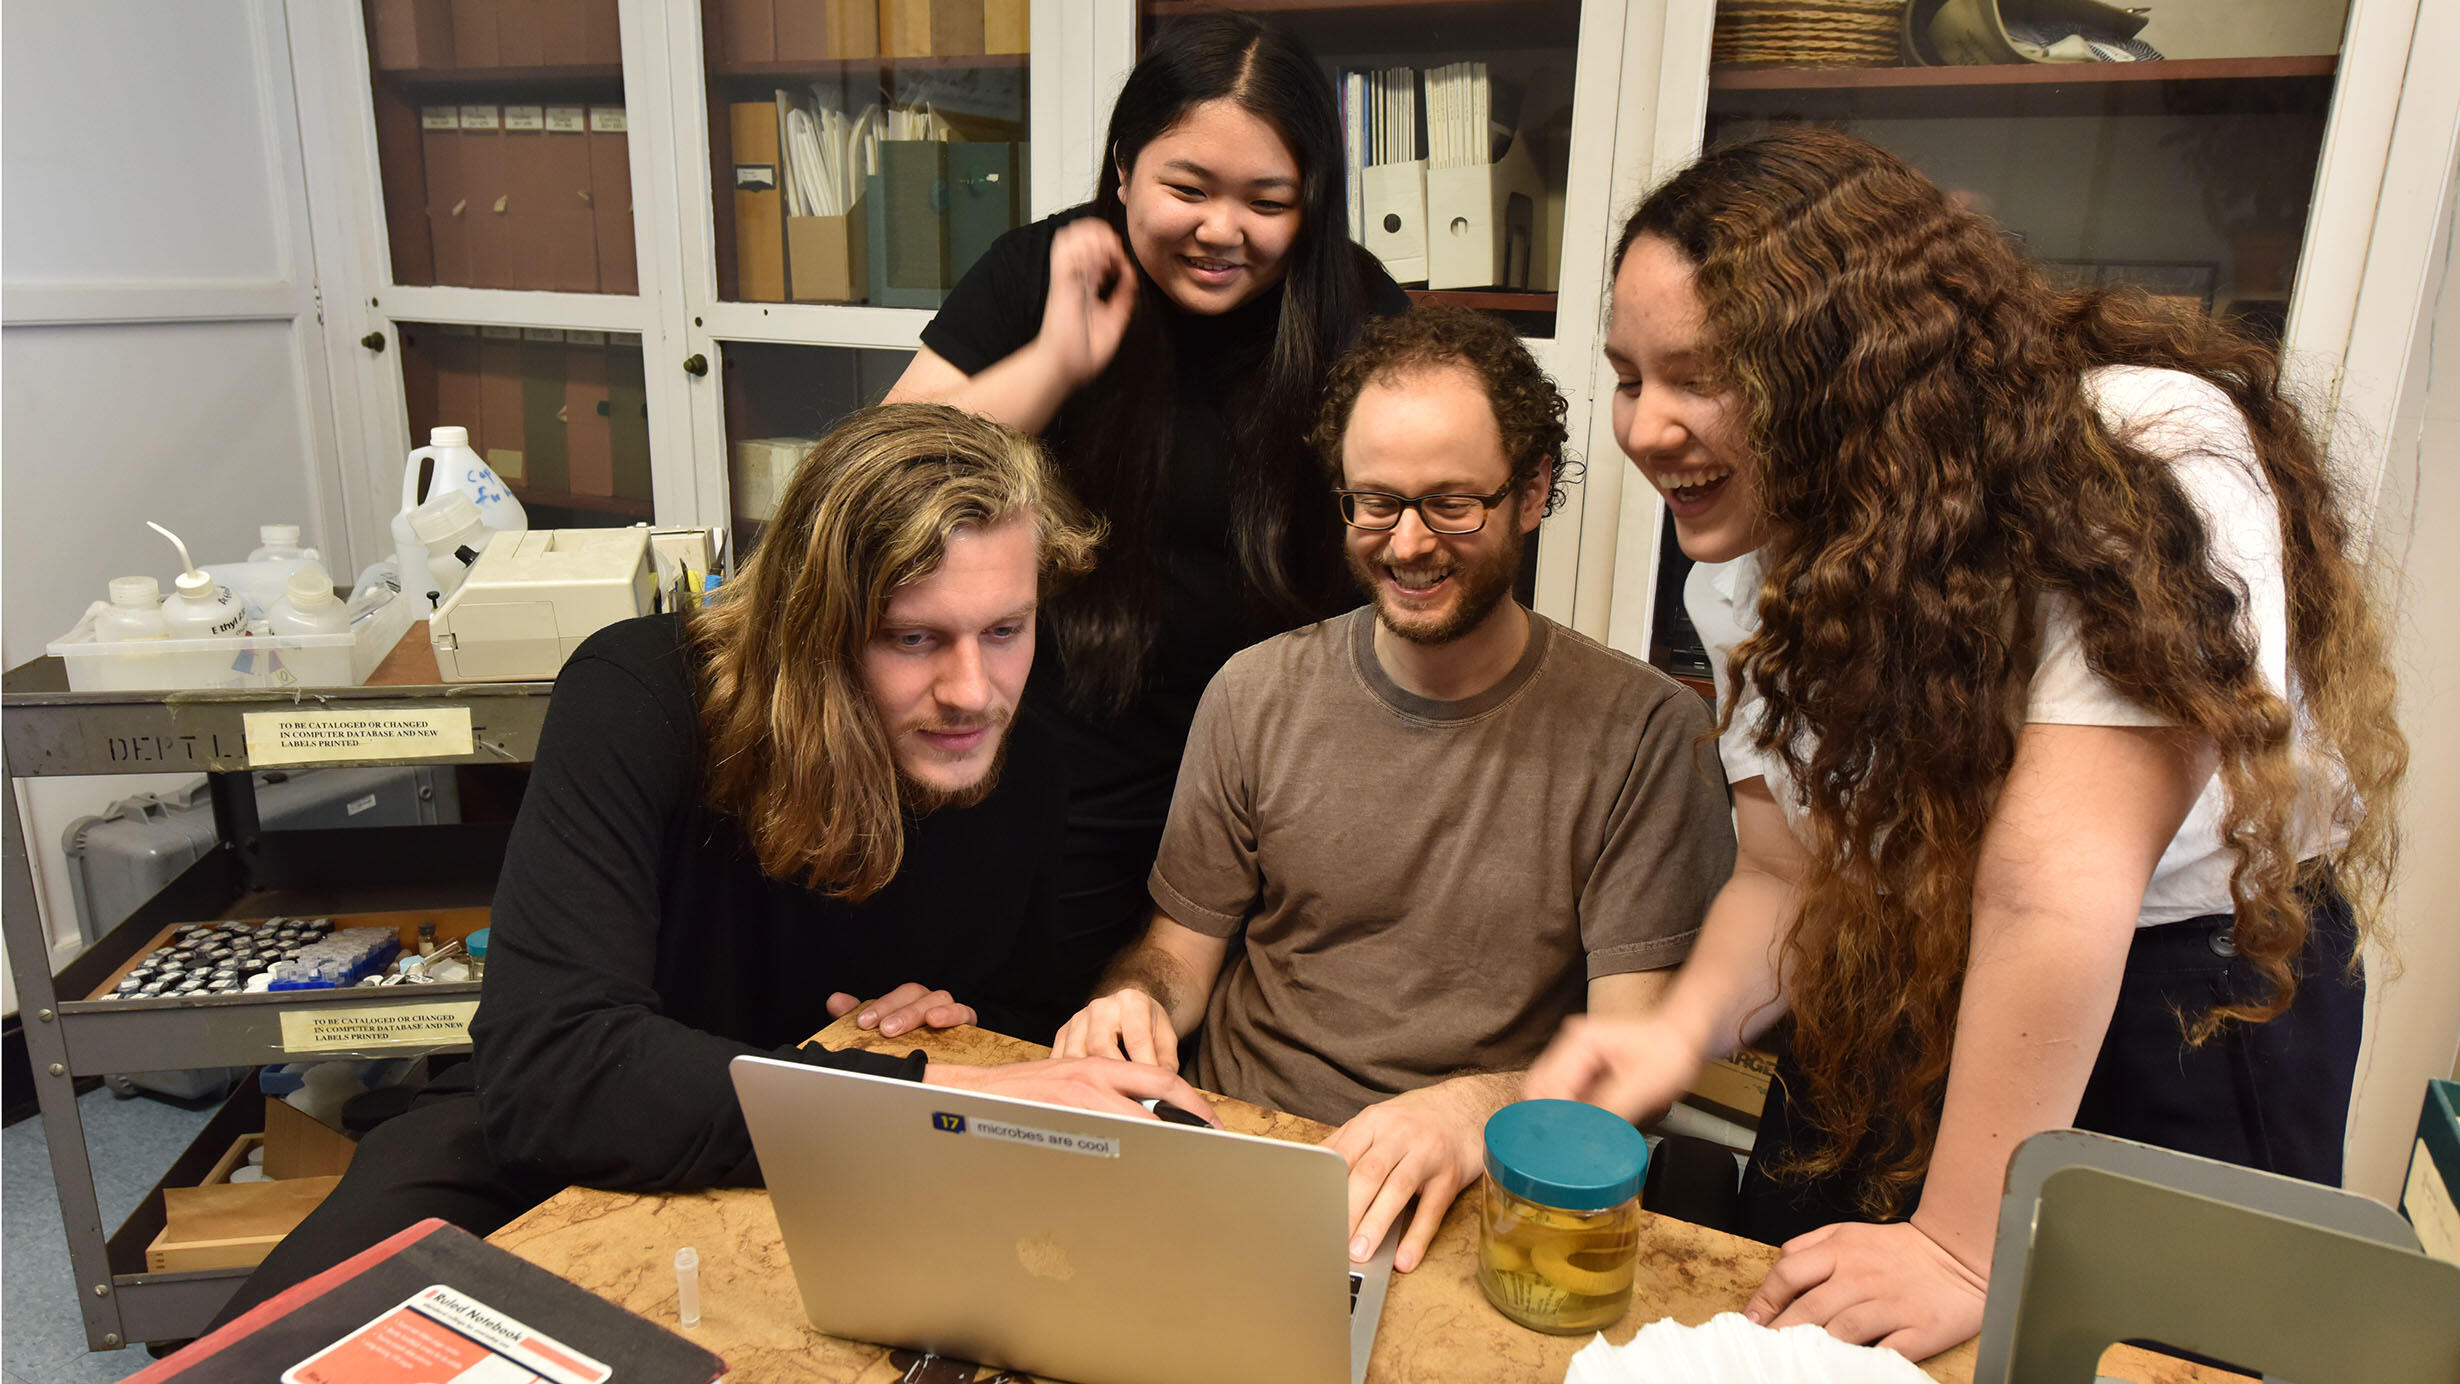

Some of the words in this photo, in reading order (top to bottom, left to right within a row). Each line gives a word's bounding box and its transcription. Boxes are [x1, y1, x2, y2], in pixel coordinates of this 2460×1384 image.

[279, 722, 292, 730] TO
[308, 721, 366, 729] CATALOGED
[383, 720, 428, 728] CHANGED
[280, 731, 292, 739] IN
[292, 730, 345, 738] COMPUTER
[346, 730, 394, 738] DATABASE
[417, 729, 438, 737] NEW
[109, 736, 197, 761] DEPT
[281, 740, 317, 748] LABELS
[318, 739, 359, 747] PRINTED
[313, 1018, 326, 1026] TO
[341, 1016, 396, 1025] CATALOGED
[412, 1014, 455, 1022] CHANGED
[326, 1025, 376, 1033] COMPUTER
[376, 1024, 424, 1032] DATABASE
[425, 1022, 444, 1030] AND
[445, 1021, 464, 1029] NEW
[351, 1033, 389, 1041] PRINTED
[940, 1115, 959, 1129] 17
[977, 1122, 1044, 1142] microbes
[1048, 1134, 1073, 1147] are
[1077, 1139, 1109, 1154] cool
[433, 1292, 469, 1314] Ruled
[467, 1308, 524, 1343] Notebook
